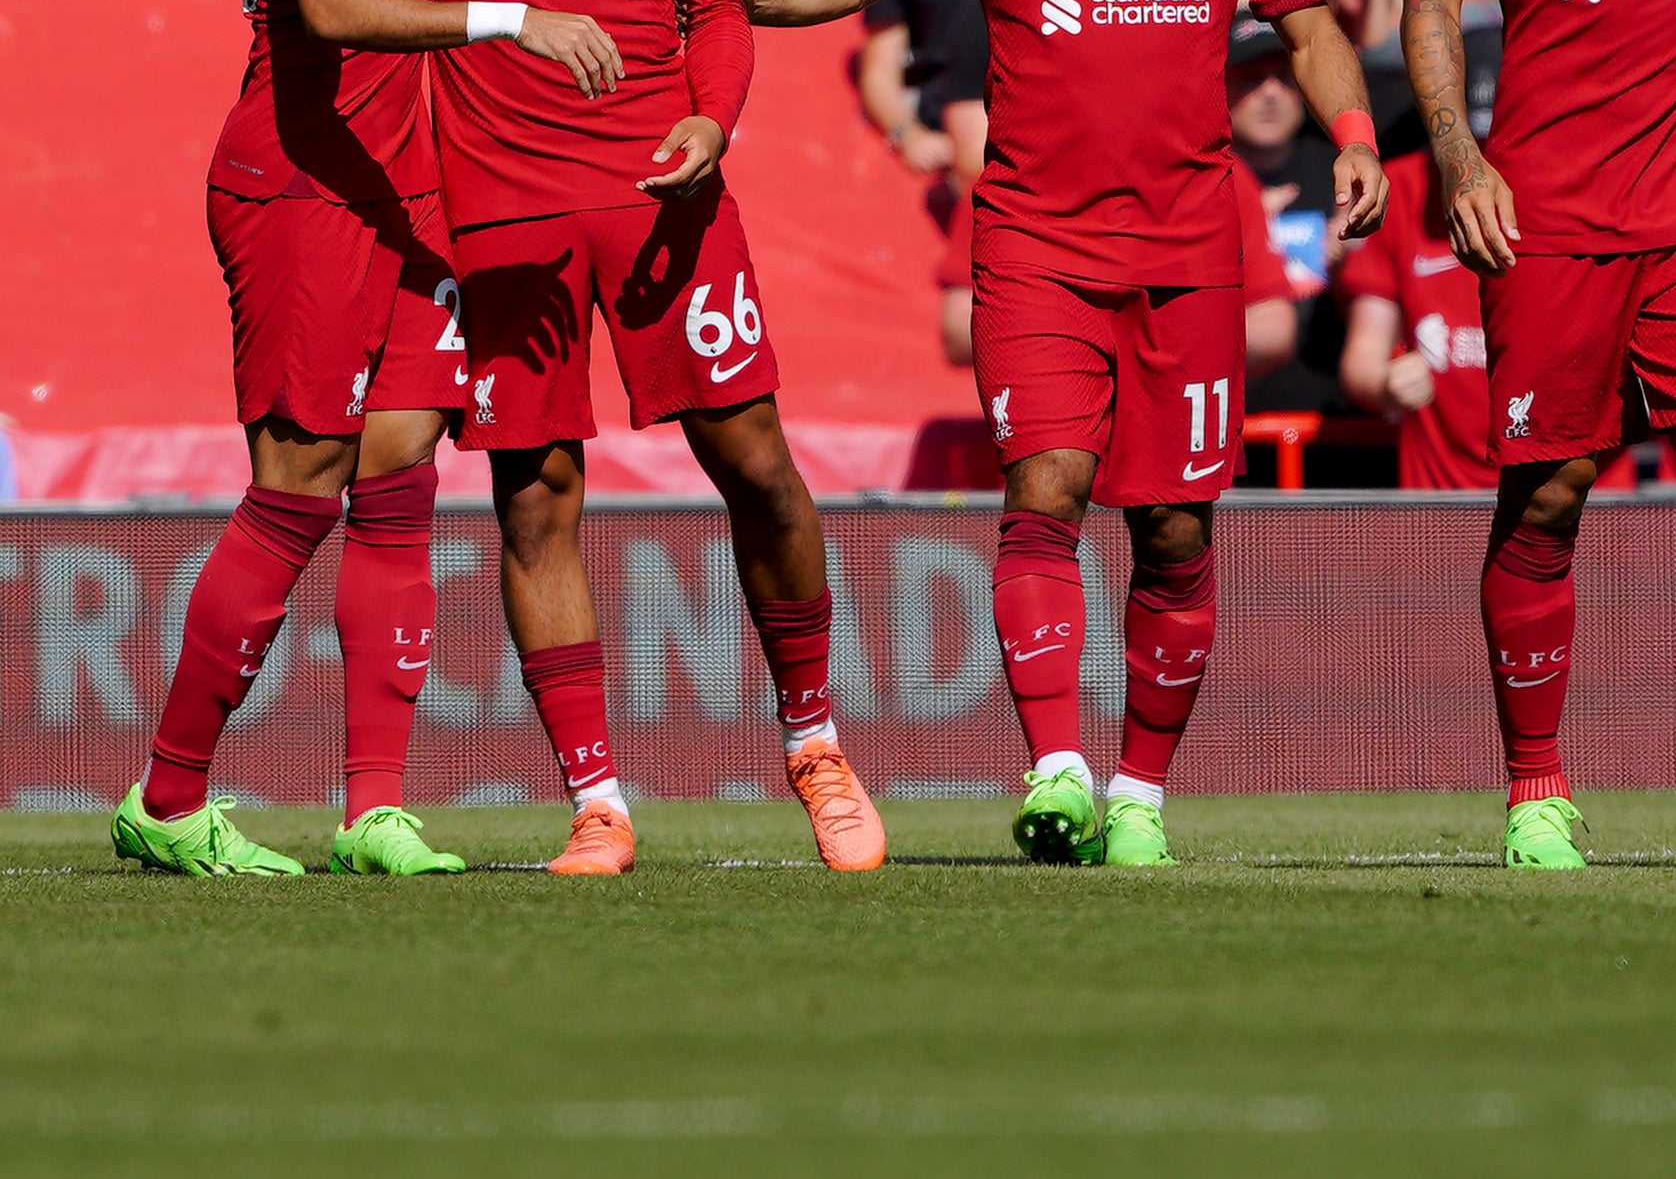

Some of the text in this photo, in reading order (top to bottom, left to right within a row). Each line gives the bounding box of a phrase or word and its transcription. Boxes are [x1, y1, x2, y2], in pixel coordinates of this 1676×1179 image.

[1092, 1, 1211, 25] chartered
[685, 271, 762, 358] 66
[1183, 377, 1229, 453] 11
